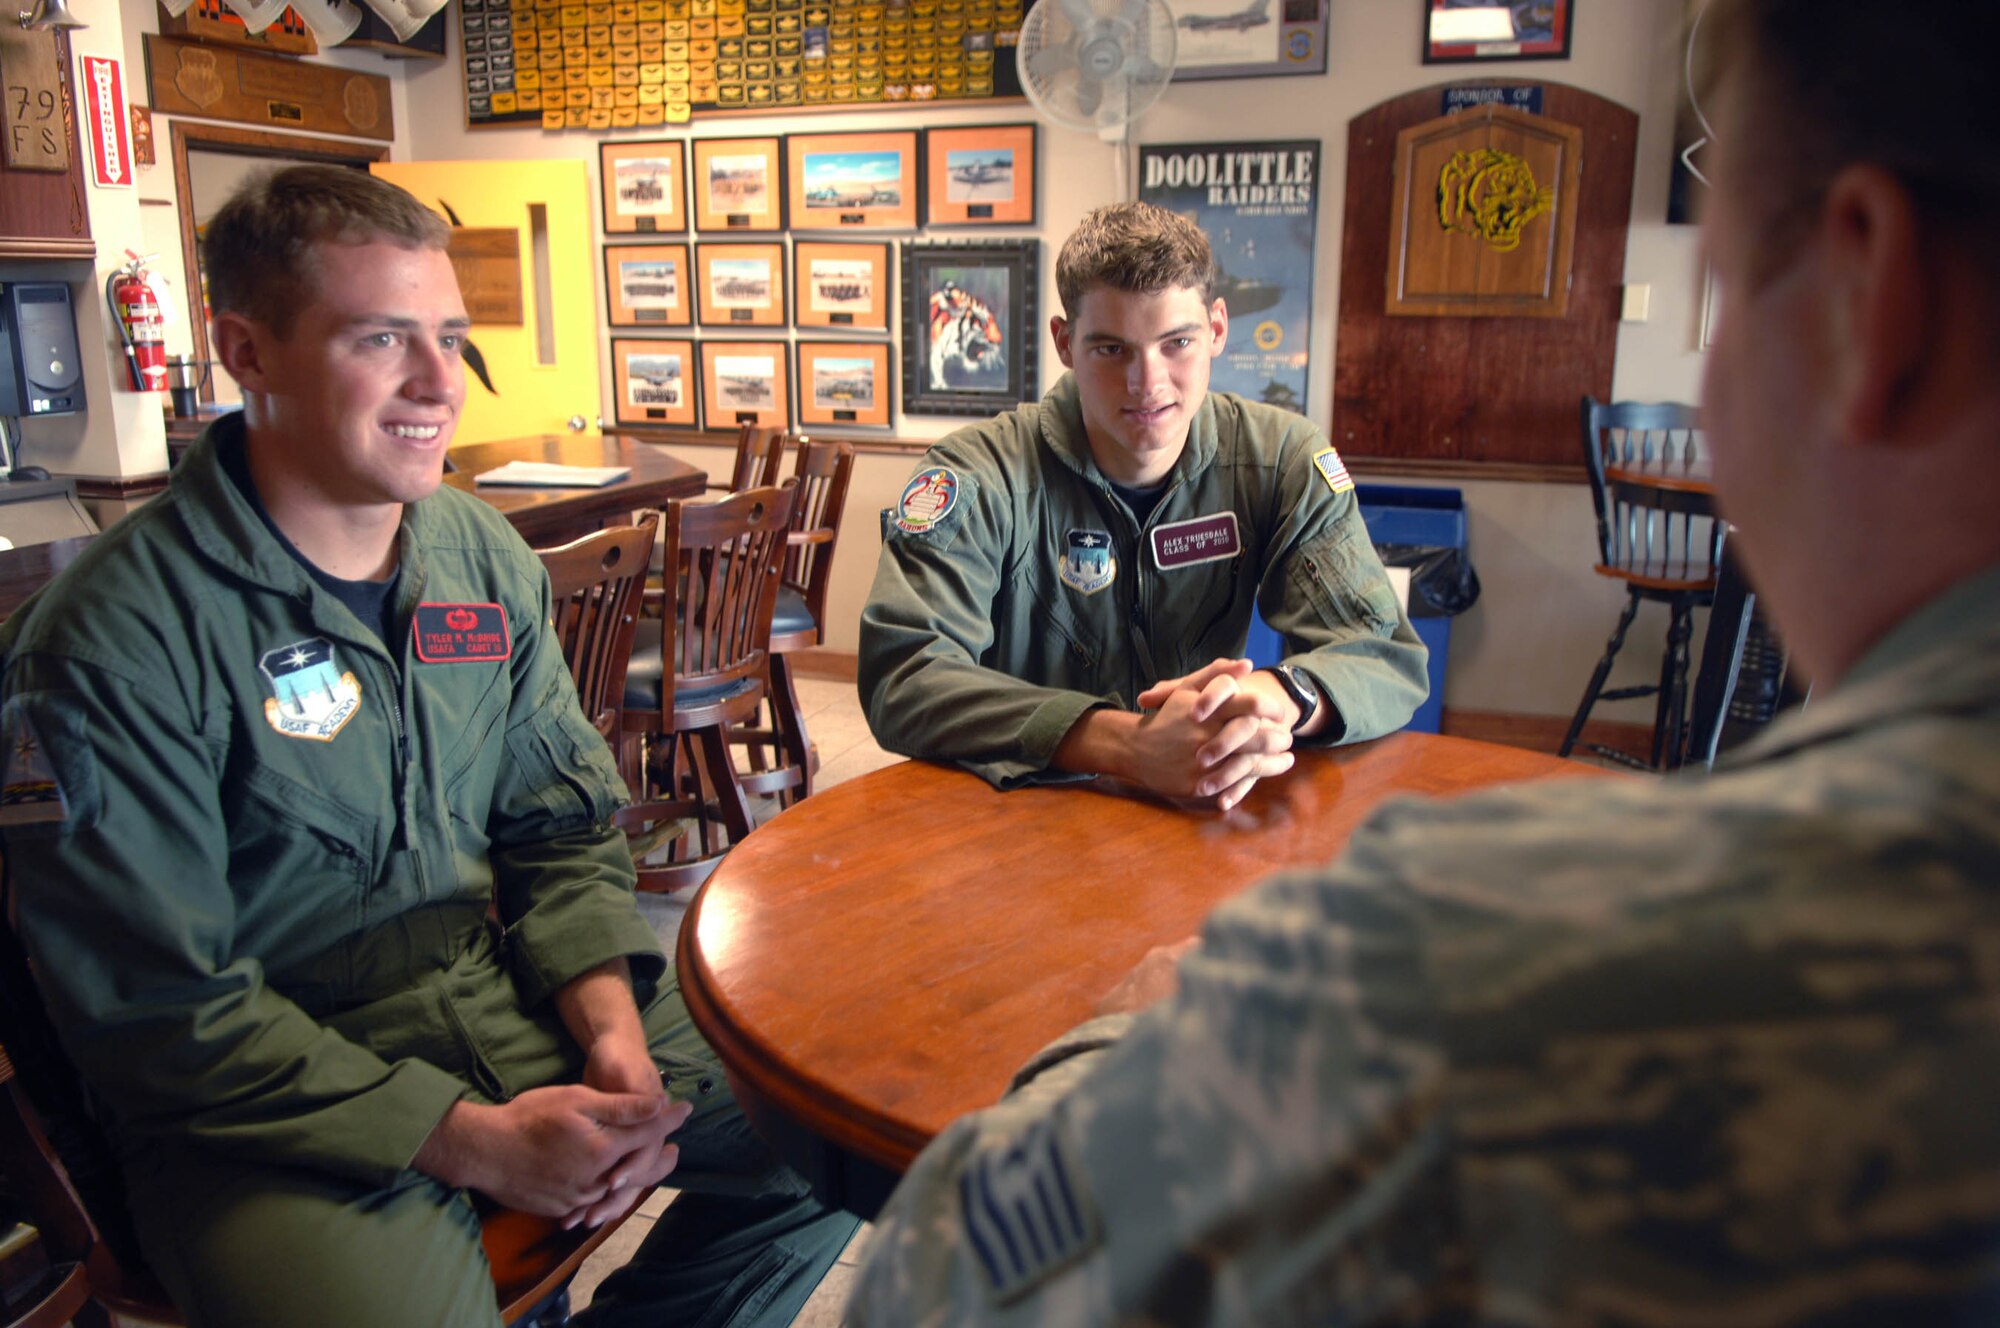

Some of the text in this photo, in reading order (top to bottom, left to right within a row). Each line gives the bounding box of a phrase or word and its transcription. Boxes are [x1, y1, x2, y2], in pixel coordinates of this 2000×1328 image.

[9, 86, 55, 120] 79
[1512, 87, 1533, 102] OF
[100, 76, 118, 174] EXTINGUISHER
[1145, 151, 1313, 188] DOOLITTLE
[1207, 184, 1311, 206] RAIDERS
[1163, 527, 1229, 549] ALEX TRUESDALE
[1163, 544, 1190, 556] CLASS
[1196, 541, 1206, 550] OF
[425, 633, 453, 643] TYLER
[280, 698, 357, 737] USAF ACADEMY
